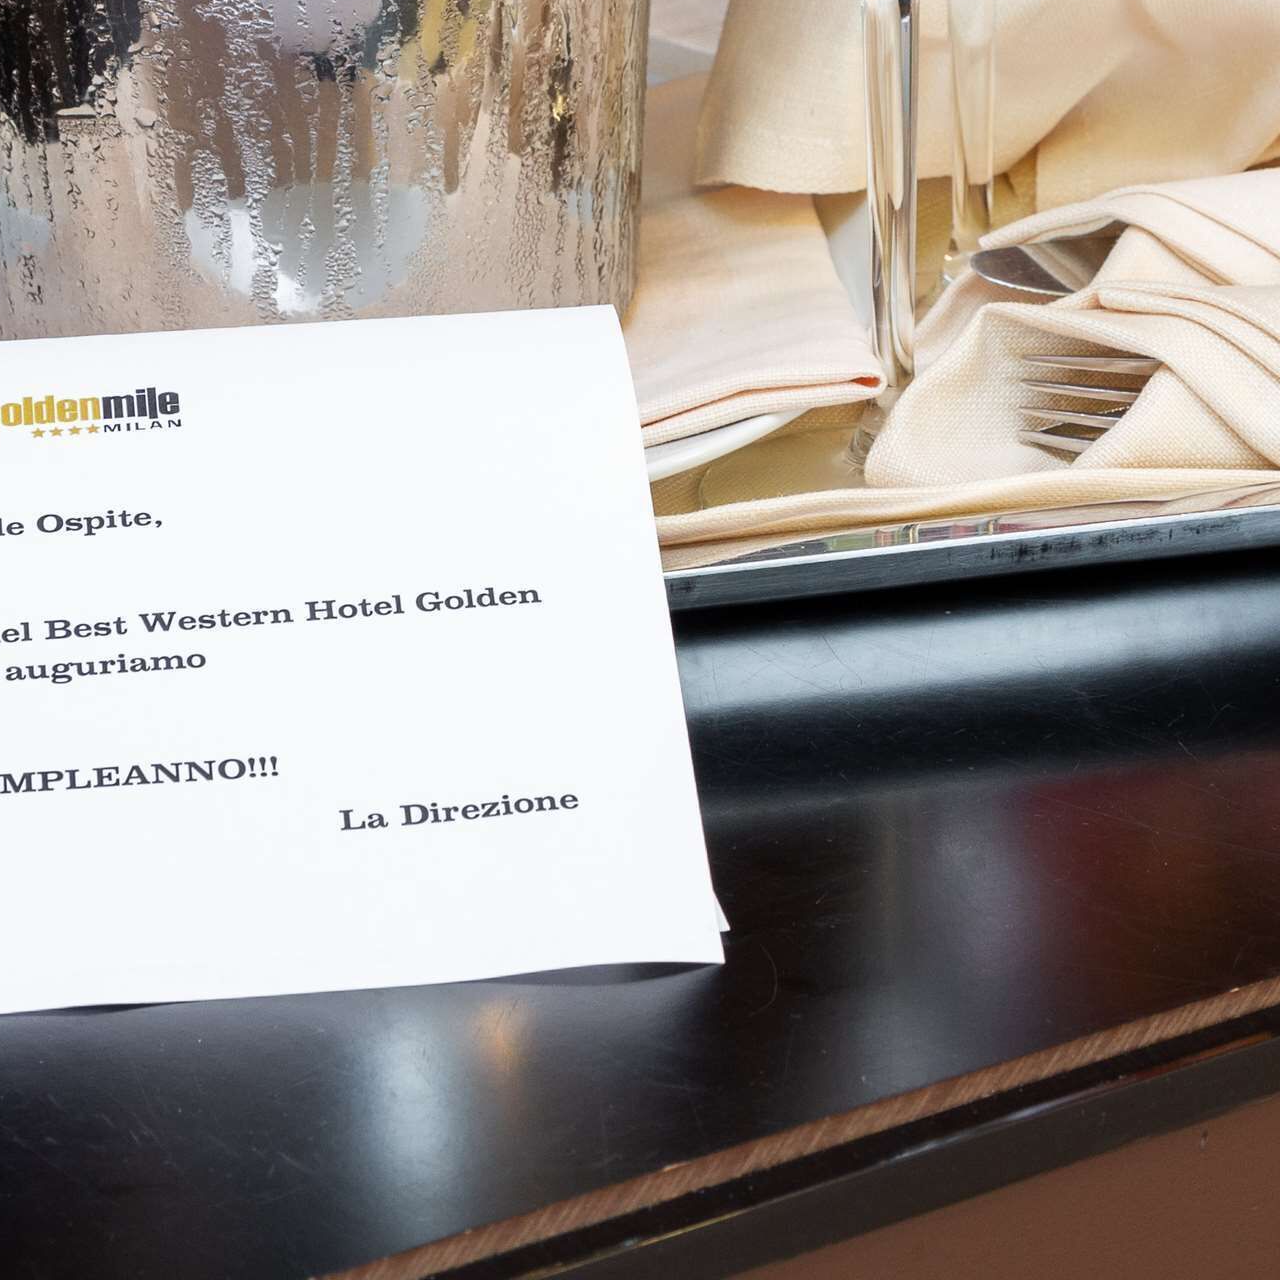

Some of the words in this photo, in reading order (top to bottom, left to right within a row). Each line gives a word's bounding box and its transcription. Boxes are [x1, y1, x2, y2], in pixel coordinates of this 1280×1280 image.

[103, 418, 182, 433] MILAN
[36, 509, 163, 537] Ospite,
[43, 616, 128, 640] Best
[138, 608, 295, 633] Western
[304, 594, 405, 622] Hotel
[415, 587, 543, 612] Golden
[5, 653, 207, 685] auguriamo
[338, 809, 389, 831] La
[399, 794, 579, 826] Direzione
